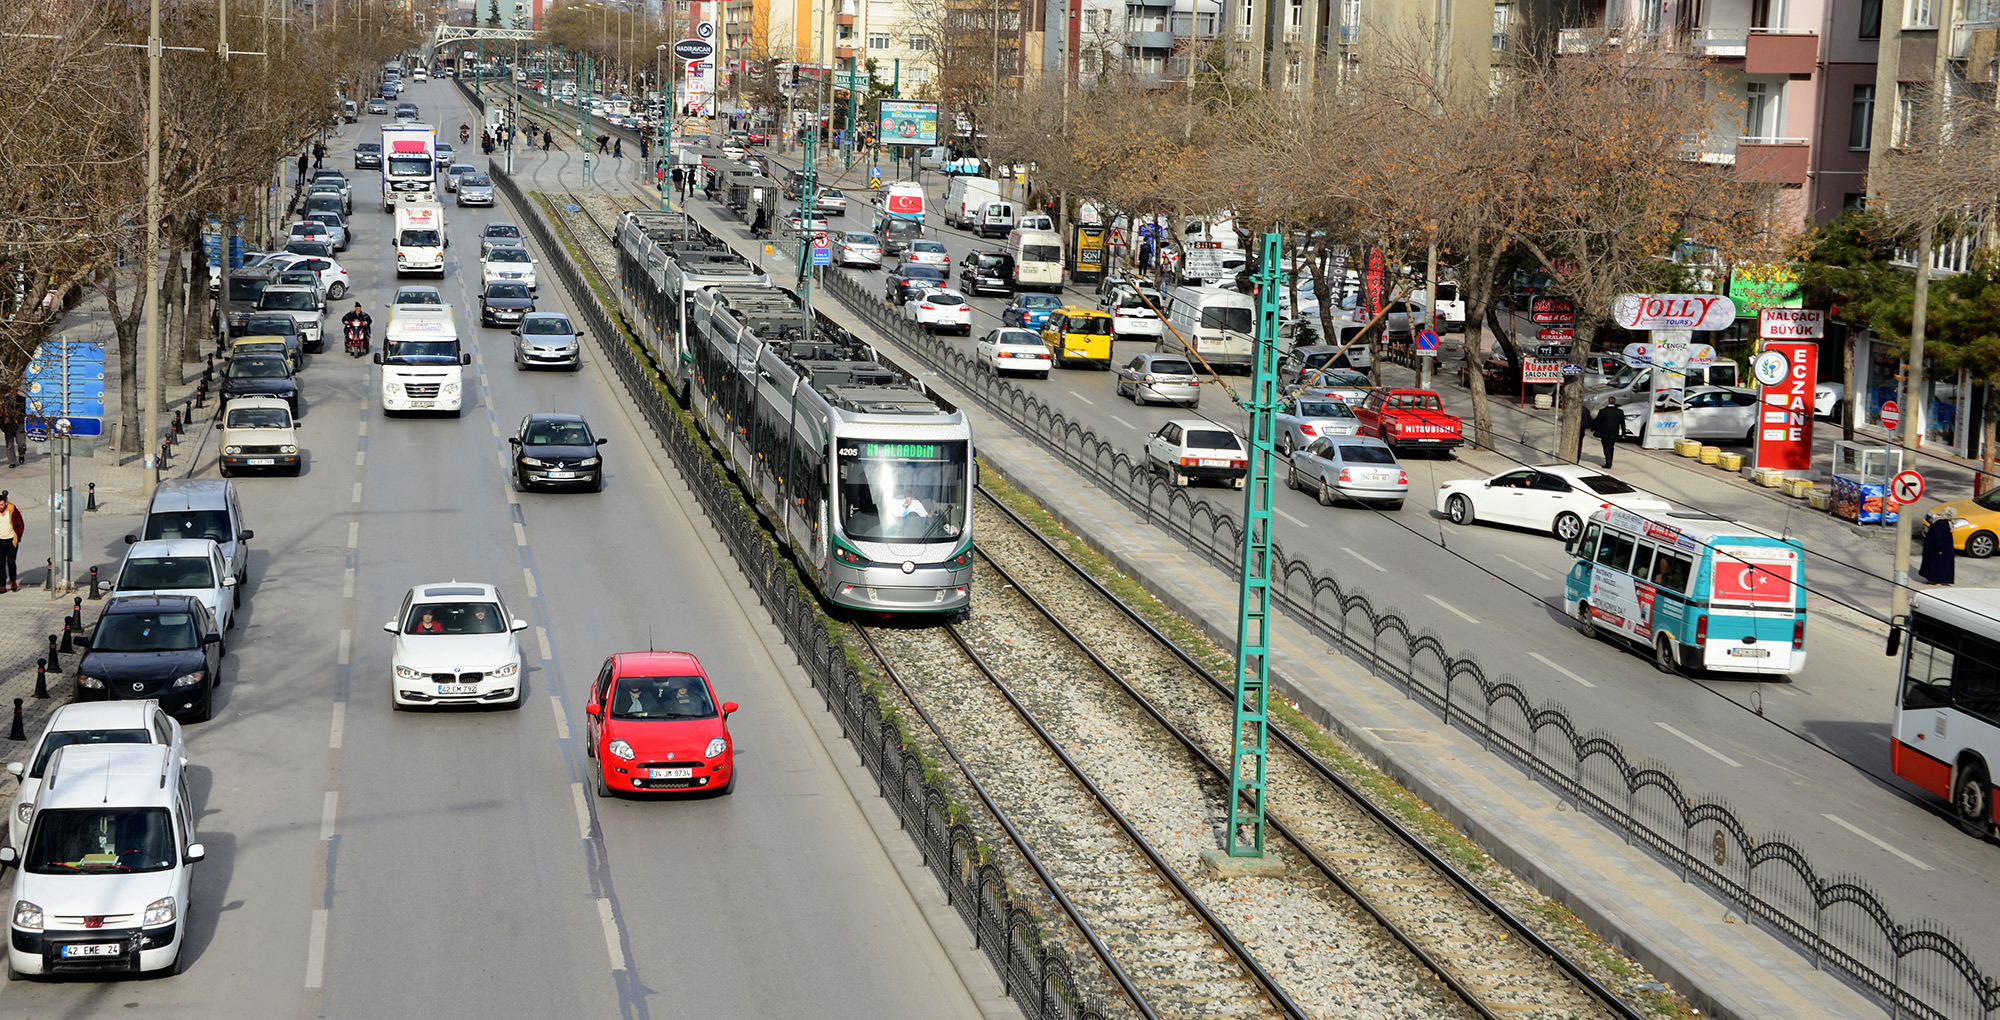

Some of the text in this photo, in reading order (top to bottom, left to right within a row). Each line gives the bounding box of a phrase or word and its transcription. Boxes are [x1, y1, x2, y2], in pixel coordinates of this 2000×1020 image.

[834, 75, 869, 86] BAKLVACI
[1630, 297, 1720, 327] JOLLY
[1767, 312, 1820, 324] NALÇACI
[1770, 324, 1814, 335] BÜYÜK
[1789, 349, 1807, 441] ECZANE
[1405, 425, 1454, 433] MITSUBISHI
[838, 448, 858, 456] 4205
[463, 685, 477, 693] 792
[664, 769, 672, 777] JM
[674, 768, 690, 776] 9734
[67, 945, 118, 955] 42 EME 24
